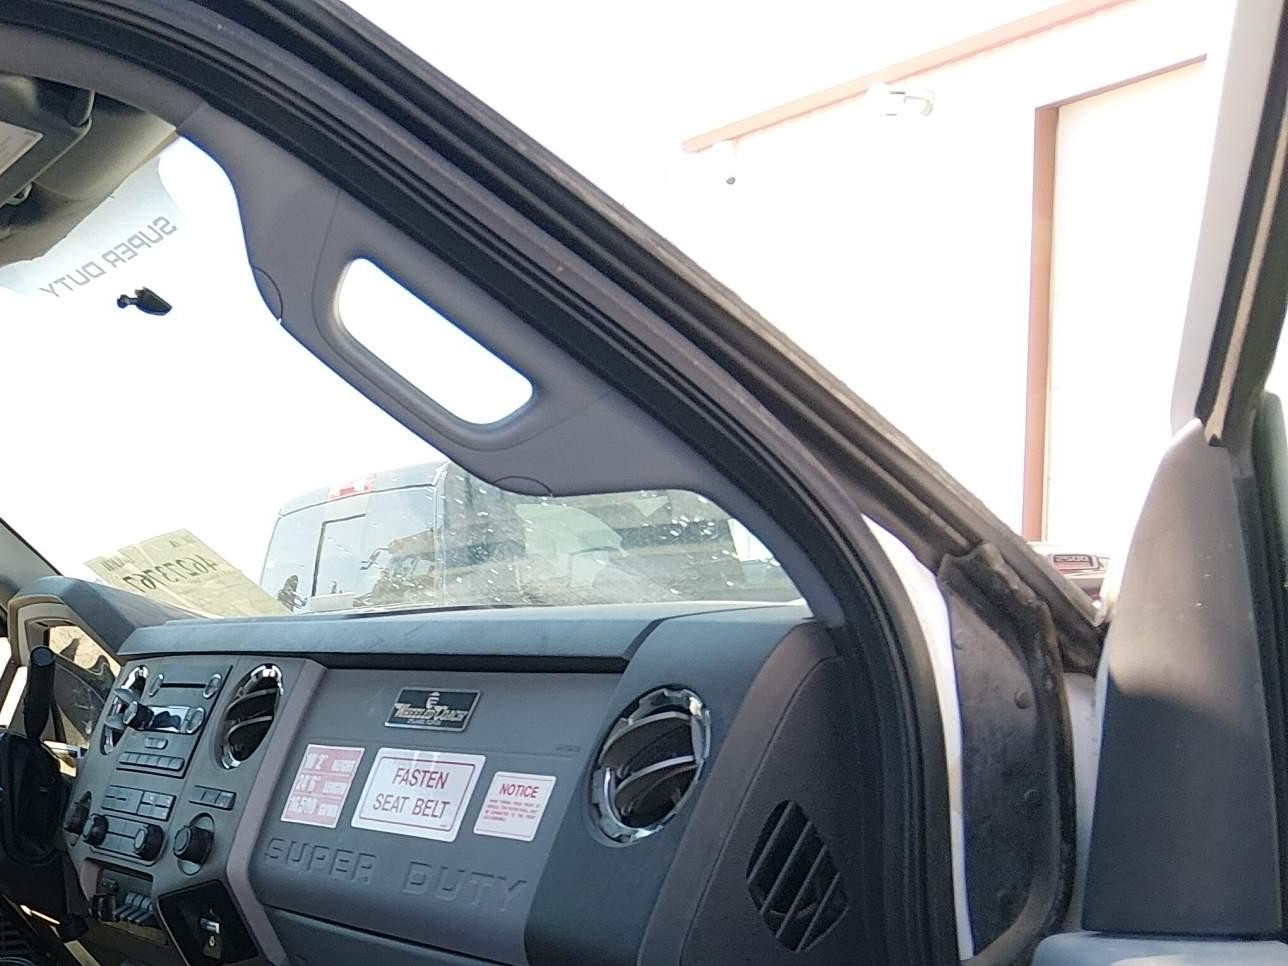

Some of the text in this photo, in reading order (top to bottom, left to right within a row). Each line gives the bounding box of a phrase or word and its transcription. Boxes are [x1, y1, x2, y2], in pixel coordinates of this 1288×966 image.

[392, 767, 450, 790] FASTEN
[499, 783, 540, 798] NOTICE
[372, 792, 451, 819] SEAT BELT
[263, 837, 528, 912] SUPER DUTY
